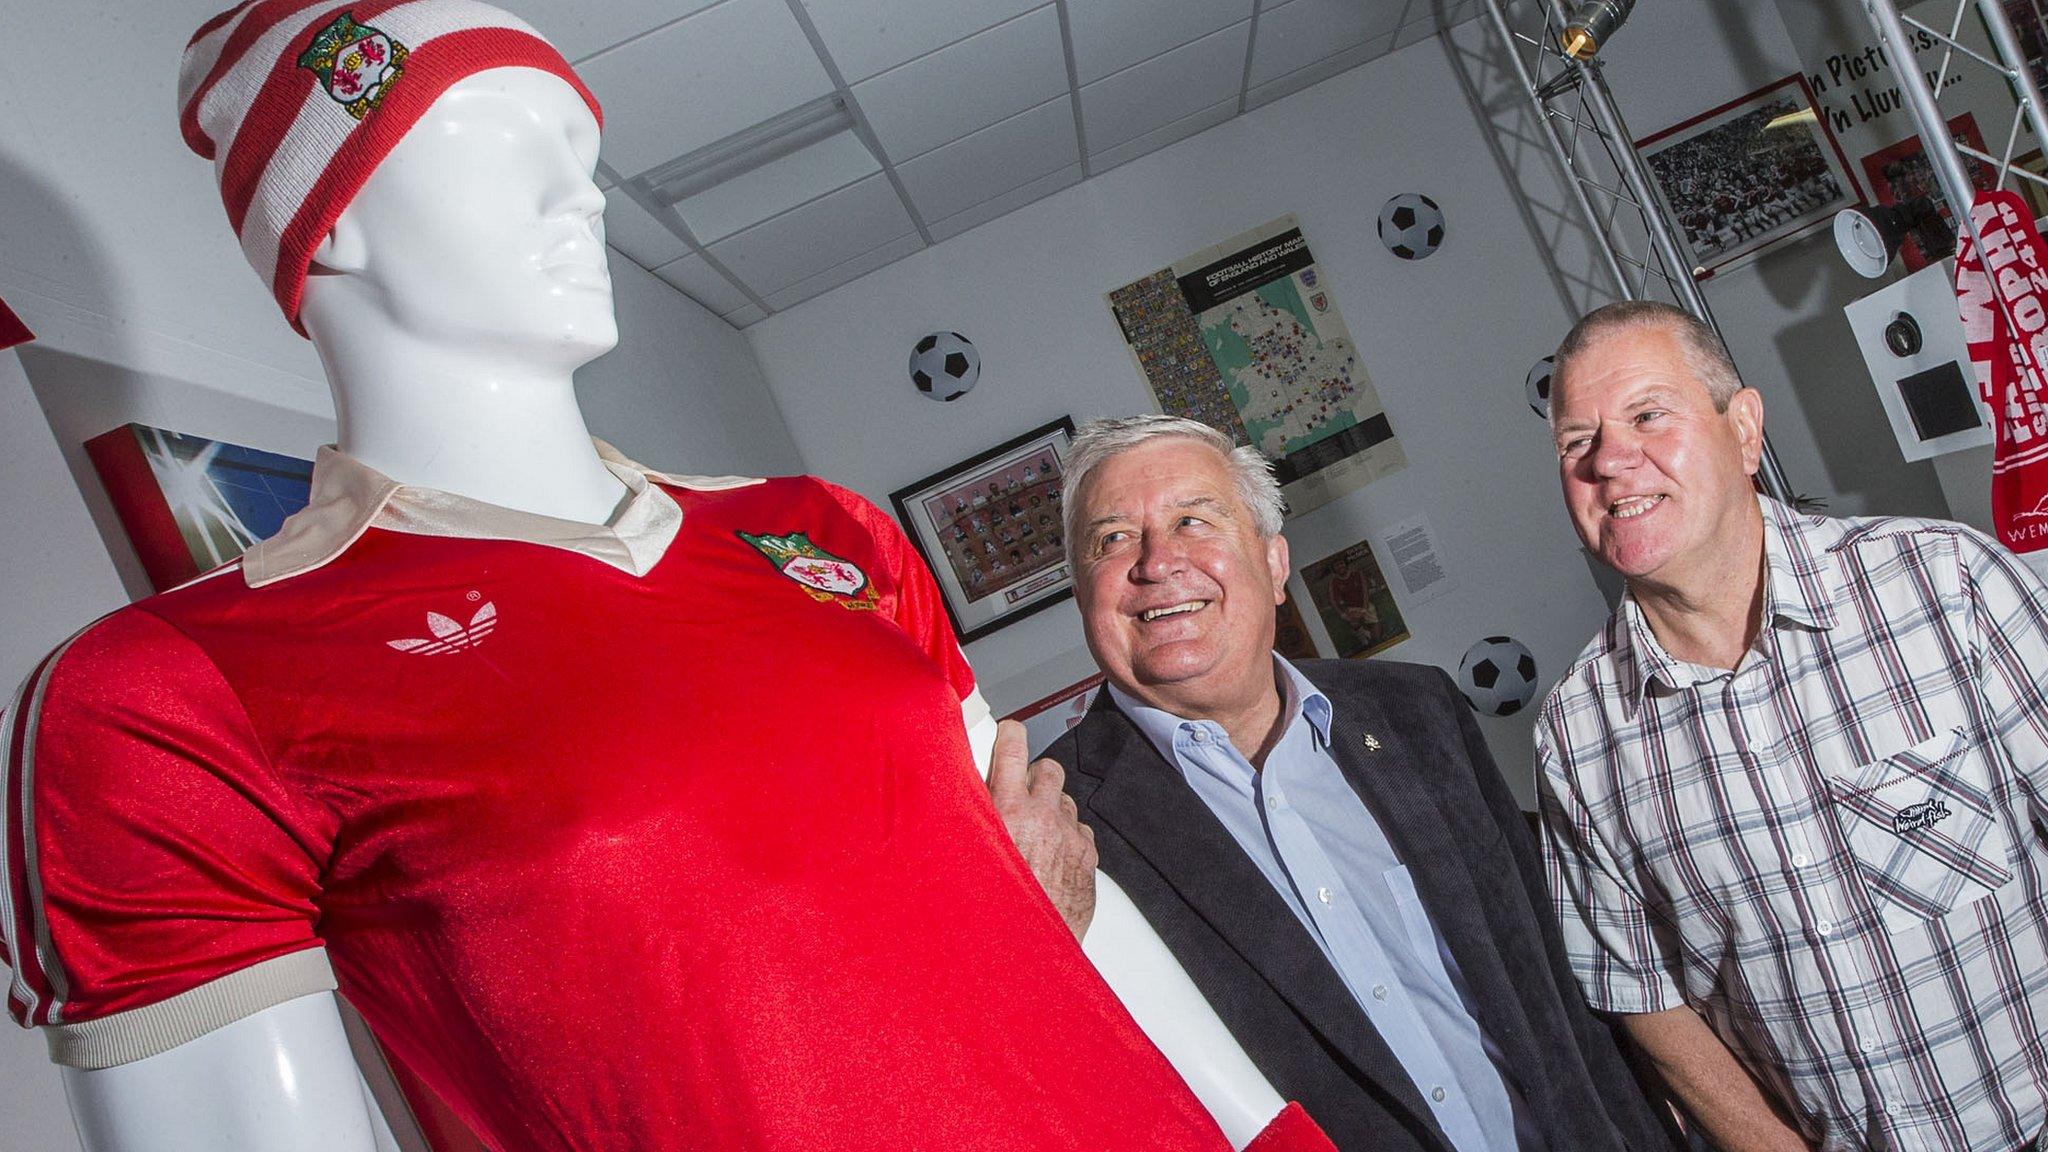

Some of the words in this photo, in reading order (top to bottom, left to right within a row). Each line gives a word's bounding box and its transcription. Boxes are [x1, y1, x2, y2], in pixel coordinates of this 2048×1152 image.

[1206, 260, 1248, 281] FOOTBALL
[1248, 245, 1283, 265] HISTORY
[1208, 278, 1222, 287] OF
[1221, 261, 1259, 281] ENGLAND
[1260, 253, 1278, 266] AND
[1279, 241, 1306, 258] WALES
